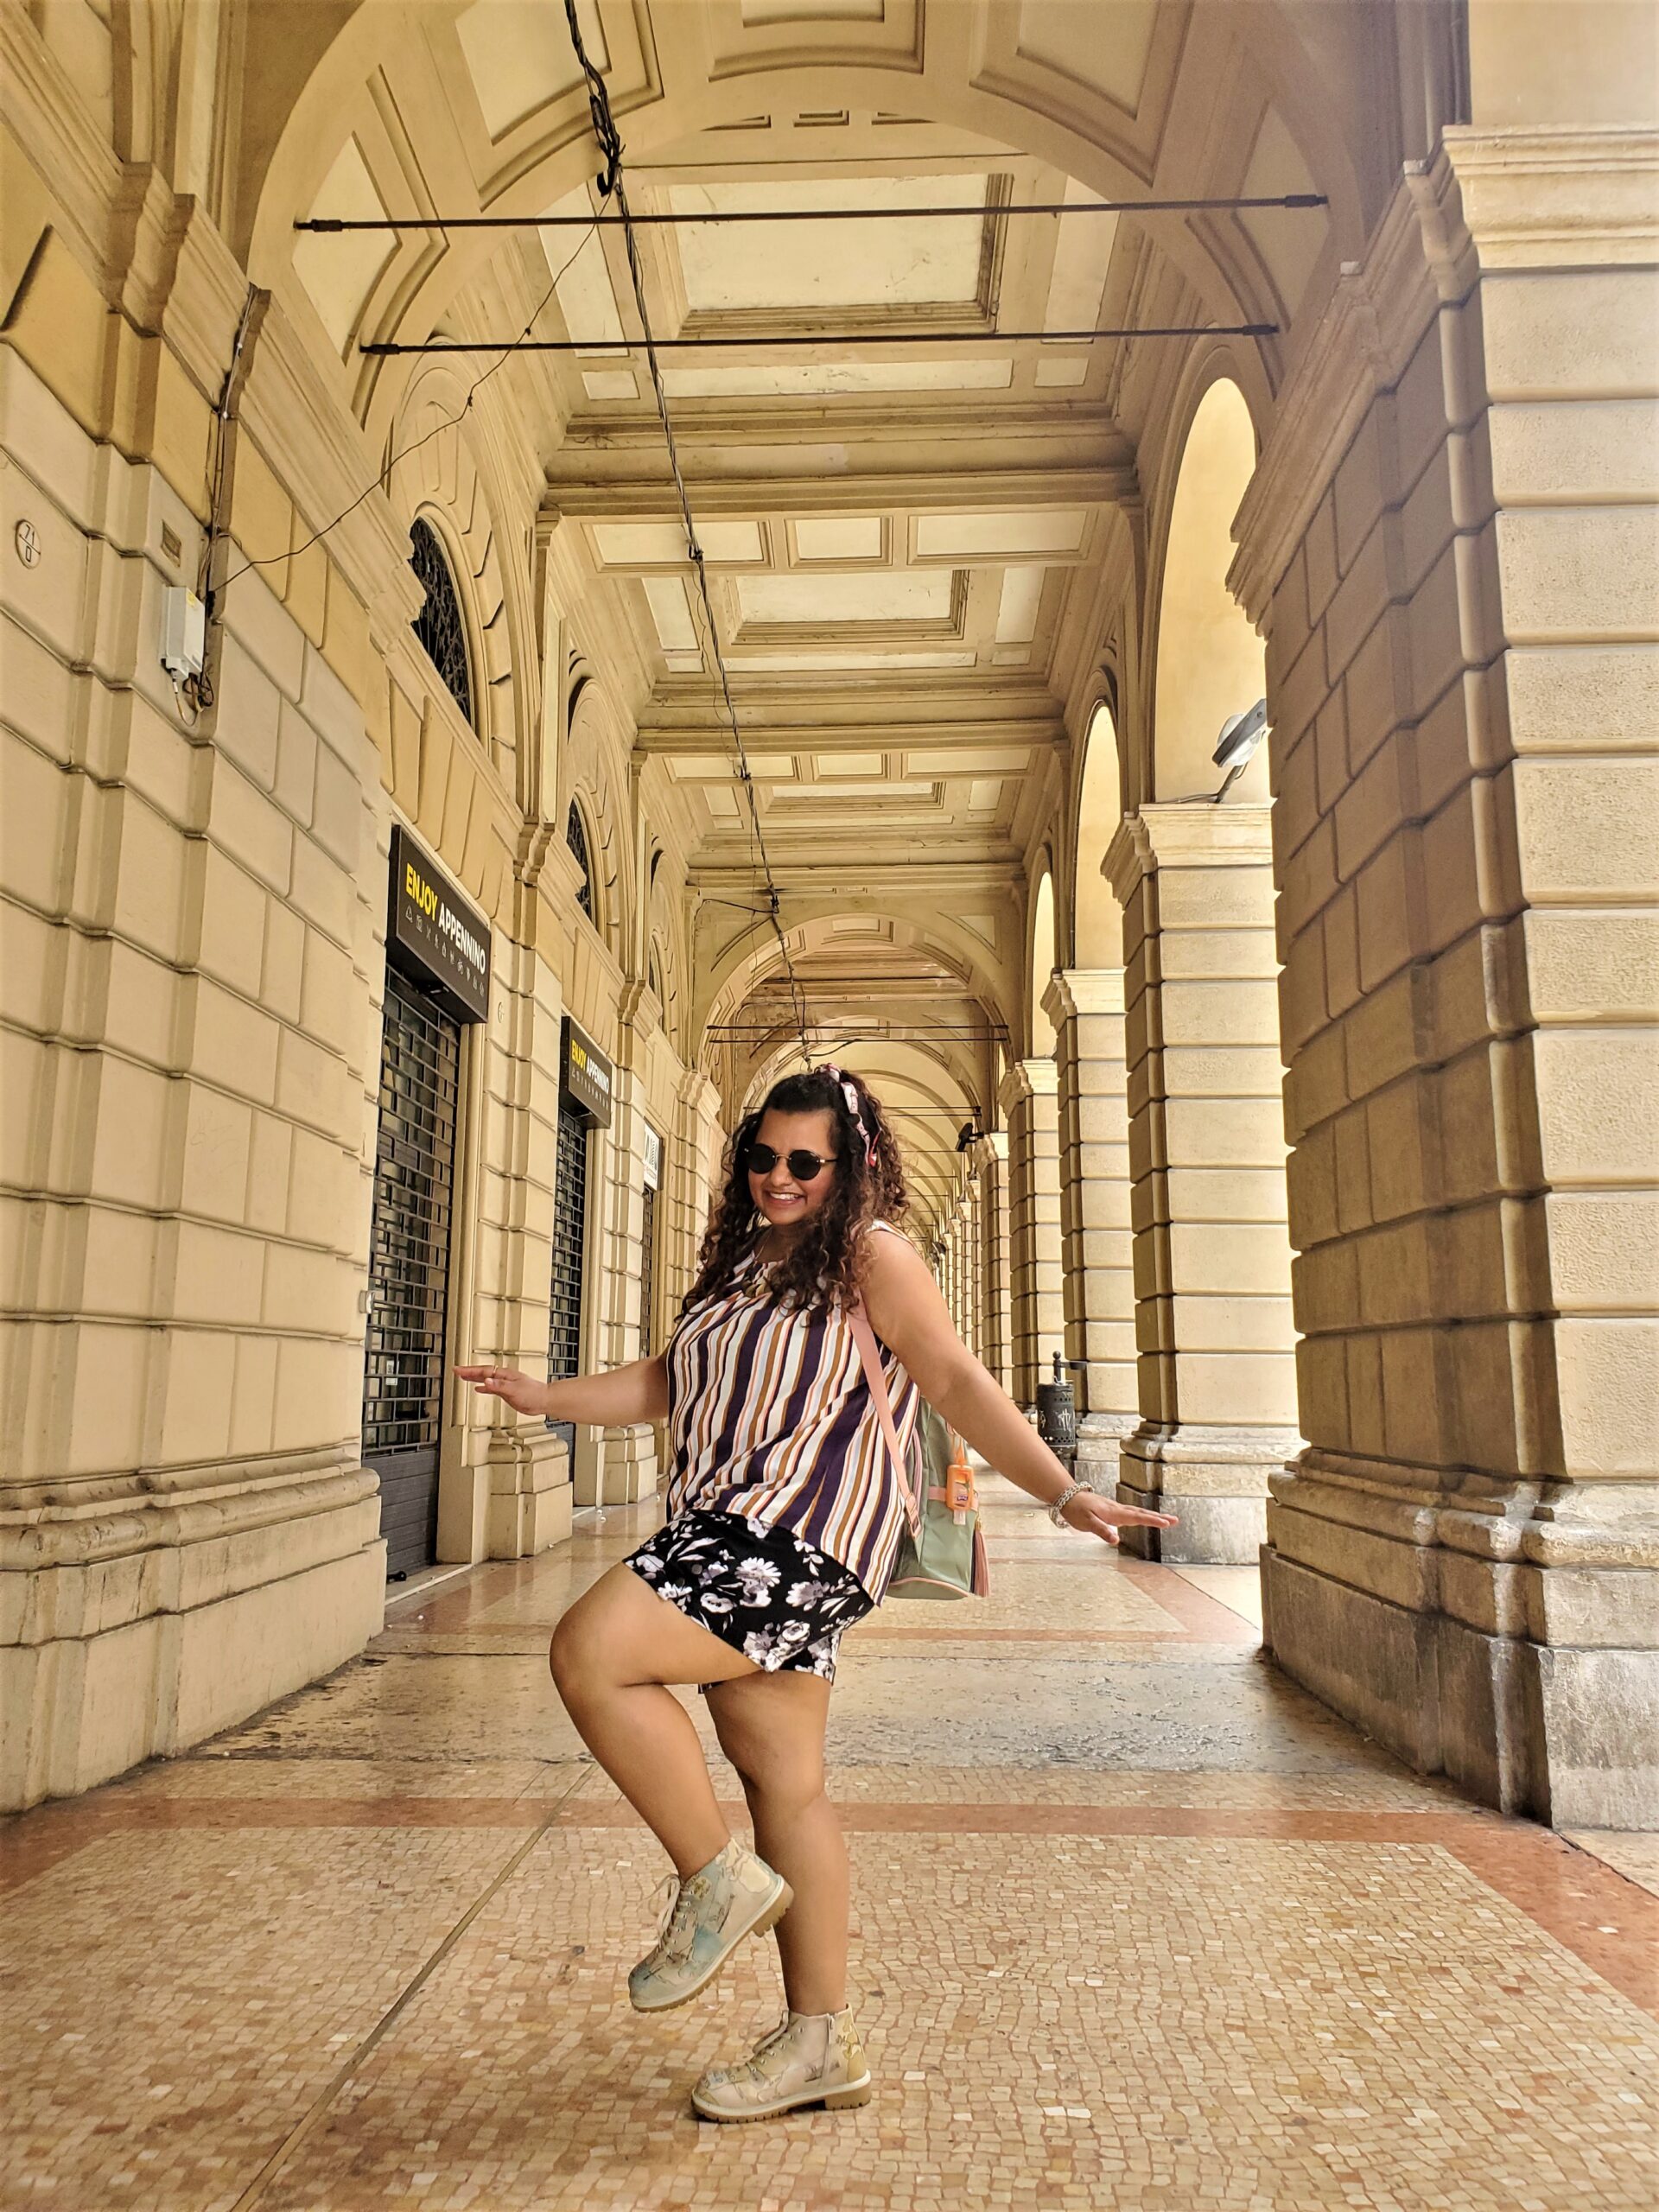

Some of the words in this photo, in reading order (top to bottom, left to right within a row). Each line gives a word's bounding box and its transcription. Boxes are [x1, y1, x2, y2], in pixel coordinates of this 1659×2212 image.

[25, 524, 35, 545] 71
[406, 862, 437, 921] ENJOY
[439, 902, 486, 975] APPENNINO
[571, 1039, 587, 1071] ENJOY
[587, 1055, 609, 1095] APPENNINO
